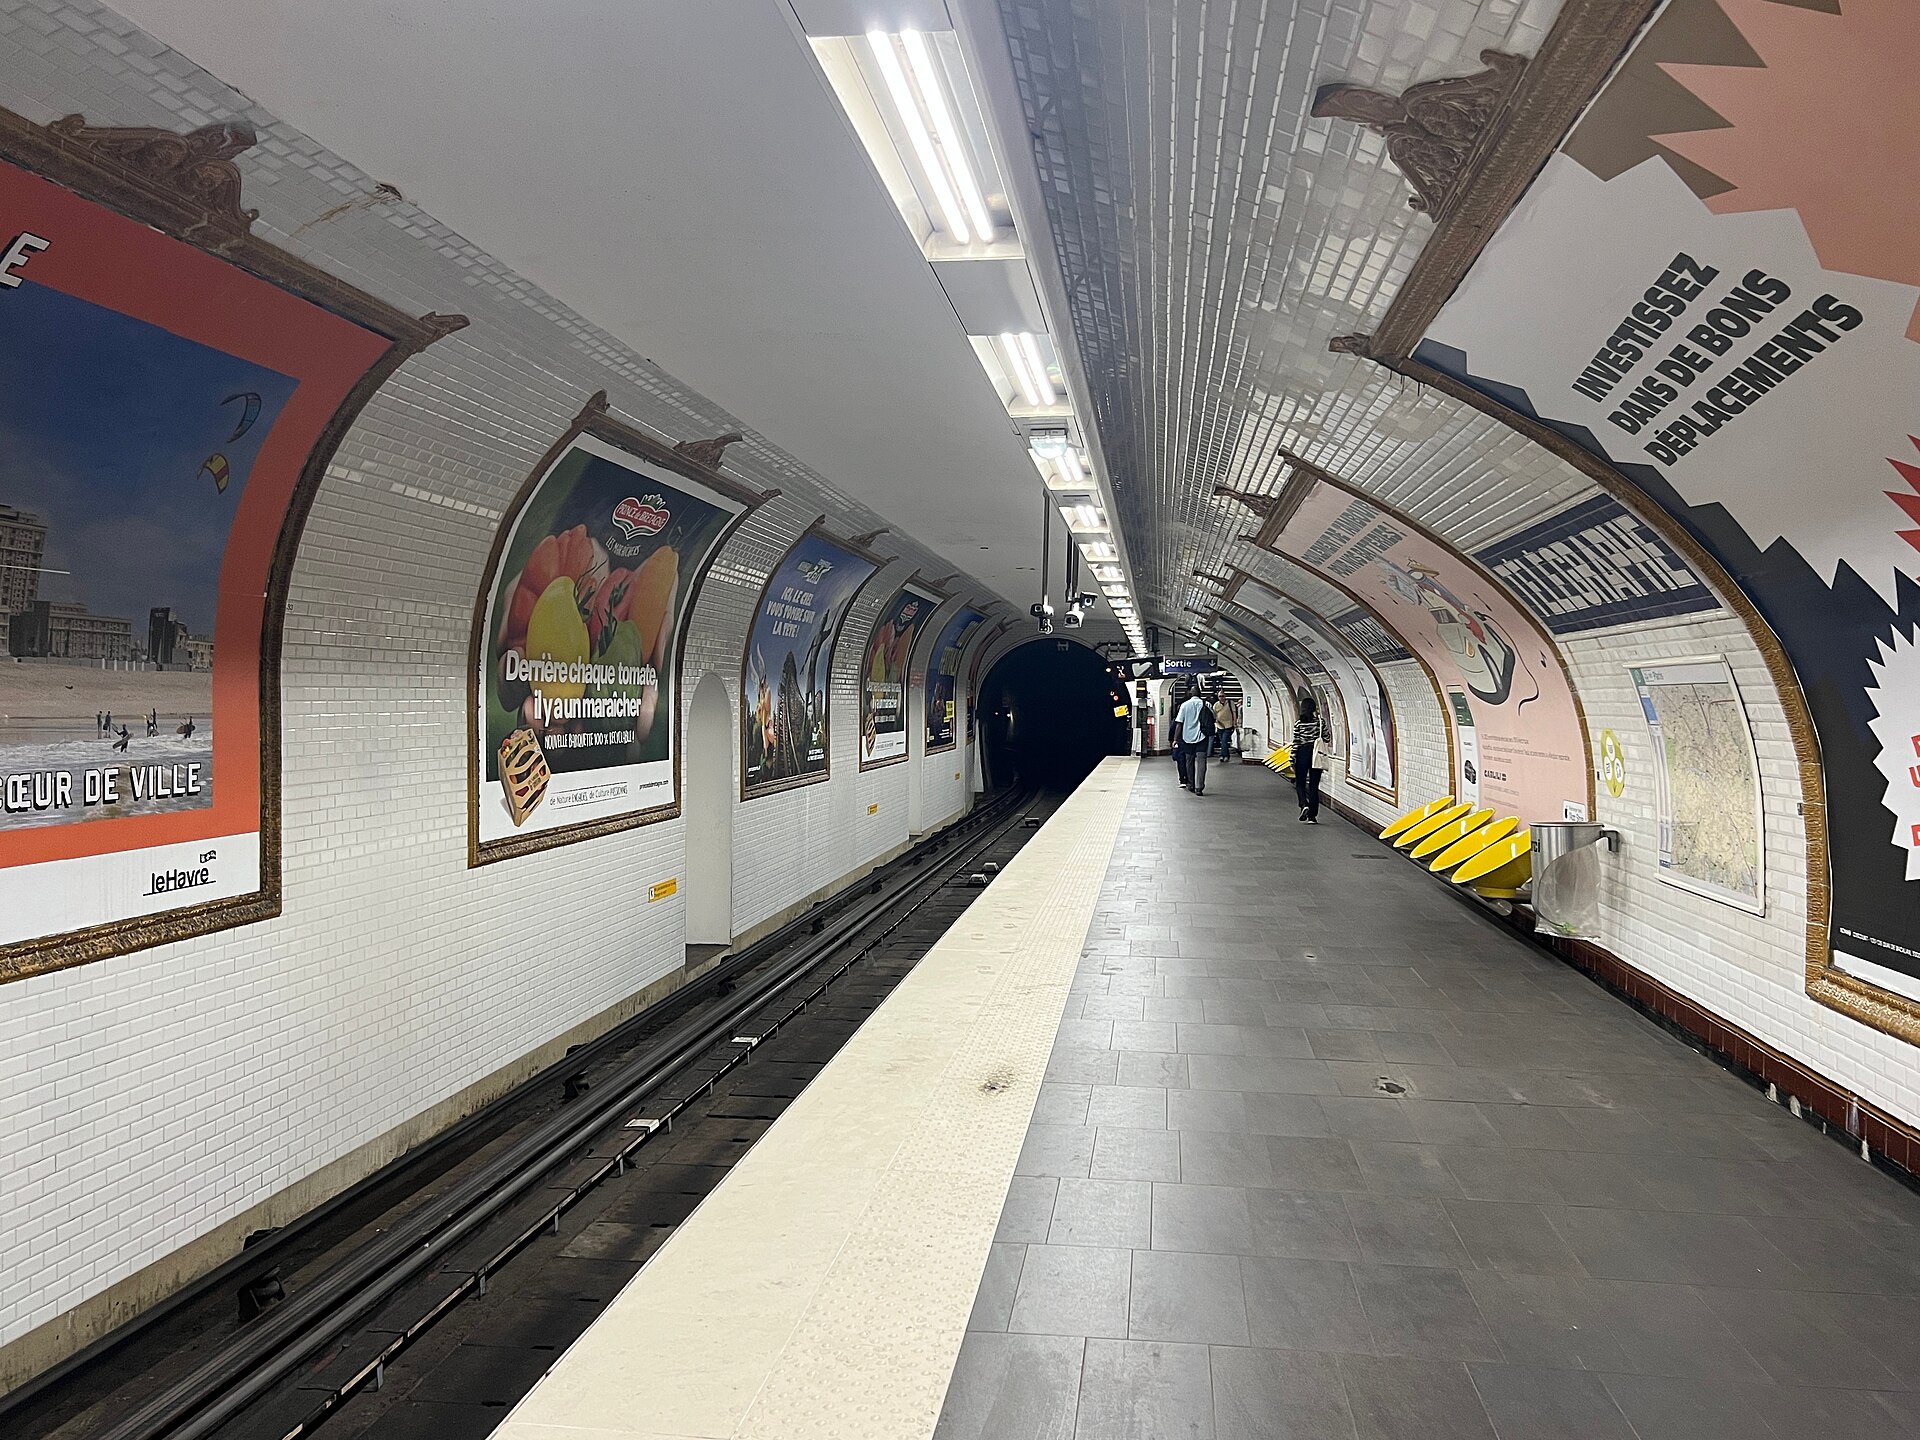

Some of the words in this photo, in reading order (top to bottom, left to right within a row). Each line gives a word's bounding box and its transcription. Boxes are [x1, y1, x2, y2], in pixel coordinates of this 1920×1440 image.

[1572, 252, 1720, 403] INVESTISSEZ
[1607, 376, 1678, 435] DANS
[1654, 344, 1713, 387] DE
[1685, 269, 1791, 357] BONS
[1643, 294, 1863, 466] DÉPLACEMENTS
[1330, 500, 1381, 537] TAMBOUR
[1349, 525, 1403, 562] BATTERIES
[766, 600, 785, 617] VOUS
[772, 621, 783, 635] LA
[506, 650, 567, 683] Derrière
[569, 656, 615, 691] chaque
[618, 662, 659, 691] tomate,
[1166, 659, 1192, 668] Sortie
[534, 690, 542, 720] il
[543, 698, 553, 727] y
[554, 698, 564, 719] a
[565, 697, 582, 719] un
[583, 691, 641, 718] maraîcher
[0, 769, 73, 813] ŒUR
[84, 767, 120, 806] DE
[131, 762, 201, 801] VILLE
